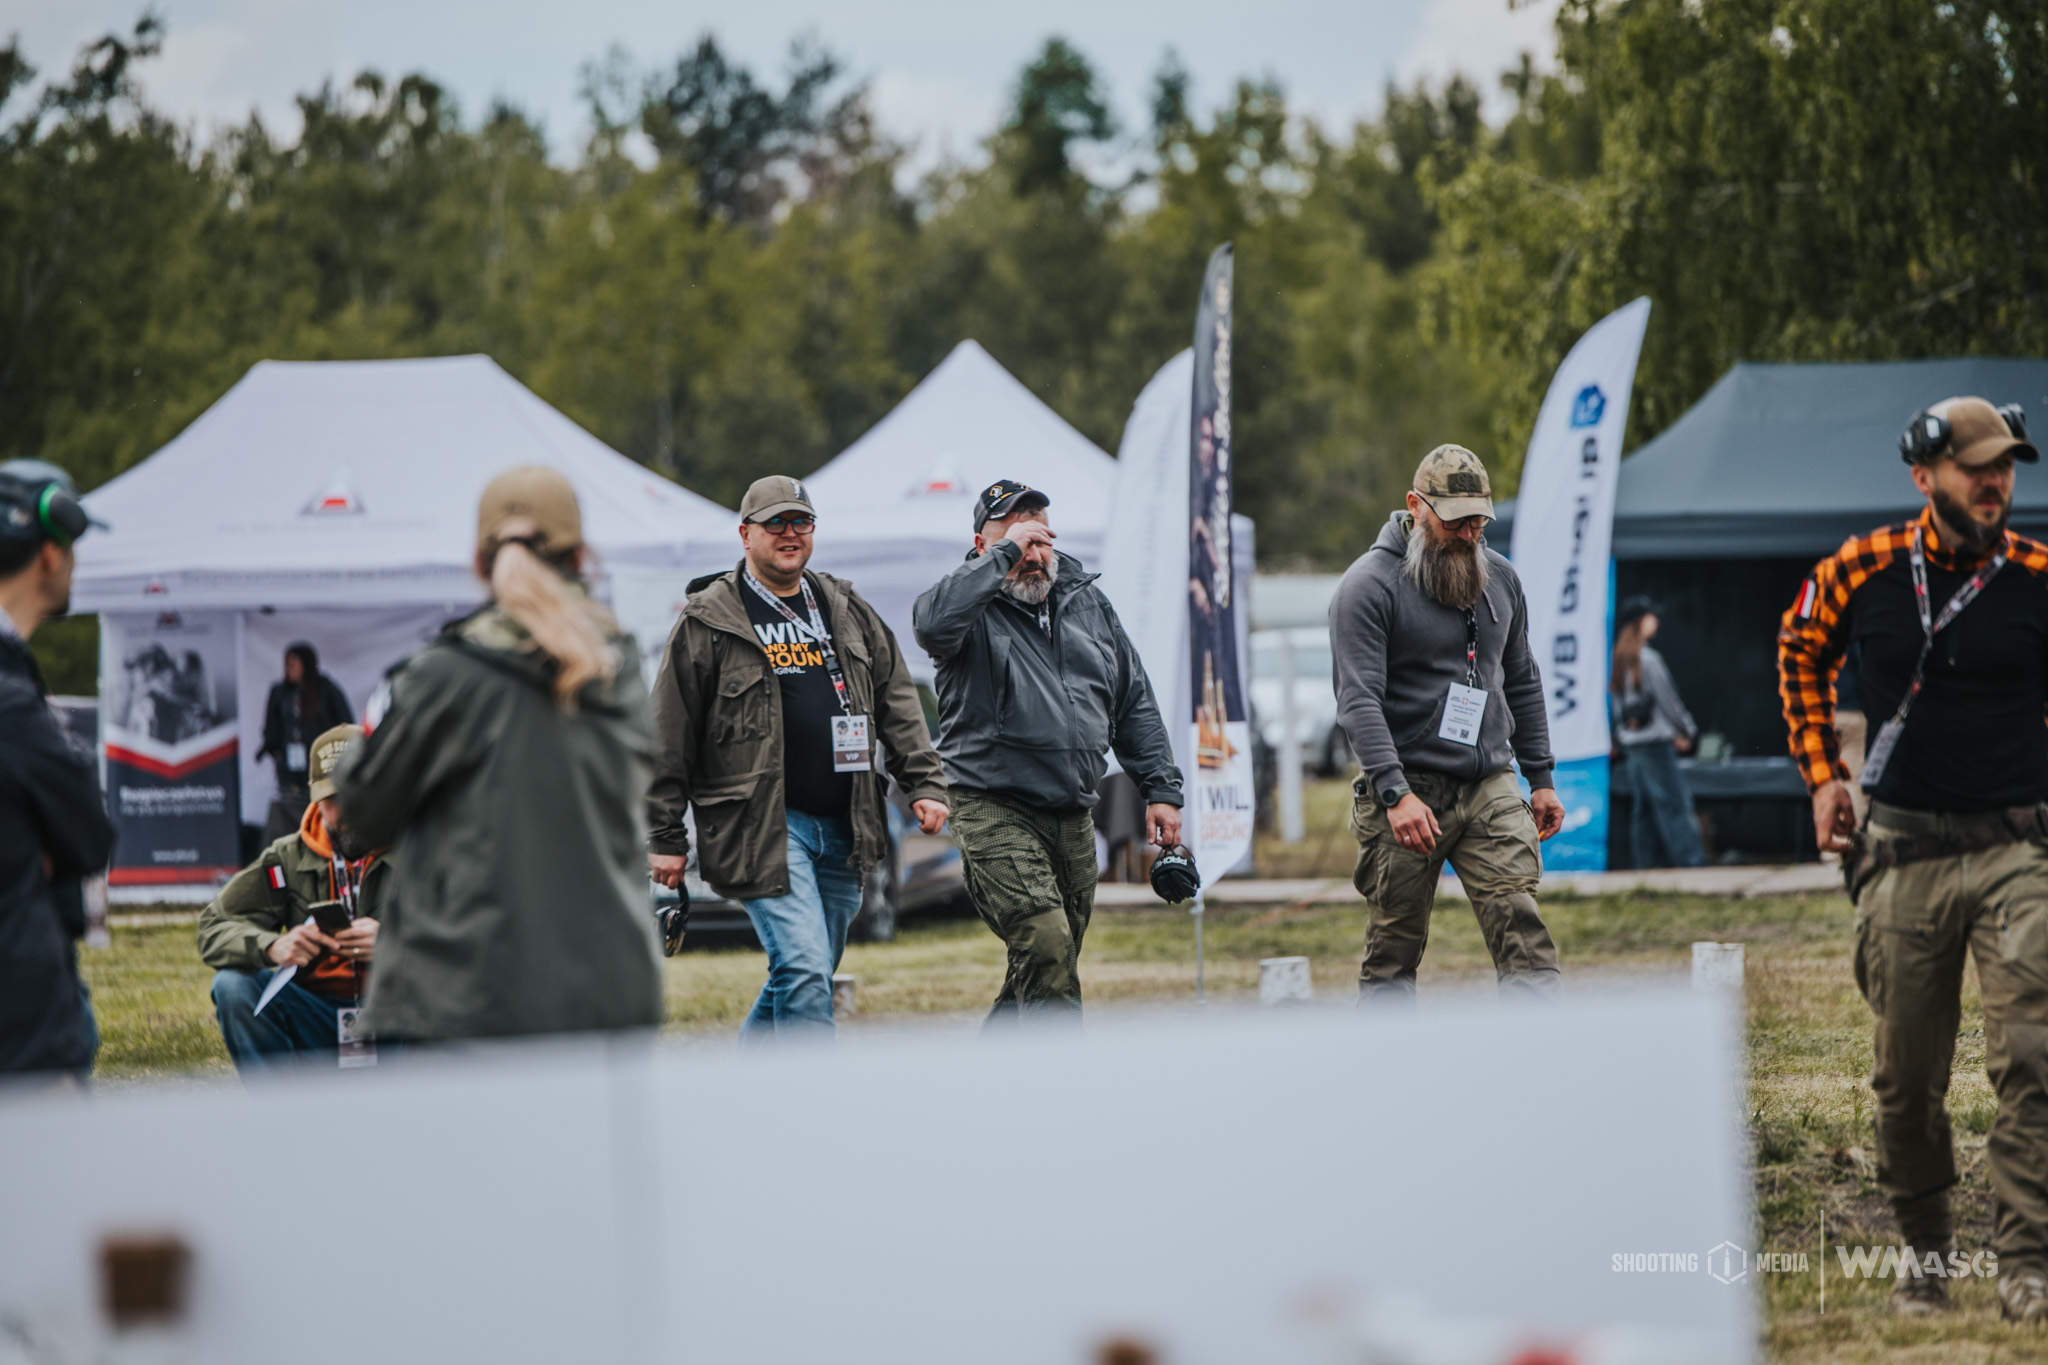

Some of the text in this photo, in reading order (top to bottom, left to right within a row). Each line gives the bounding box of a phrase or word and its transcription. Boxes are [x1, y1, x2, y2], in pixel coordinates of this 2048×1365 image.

[754, 622, 832, 645] WIL
[789, 643, 809, 652] MY
[767, 650, 824, 668] ROUN
[845, 752, 860, 761] VIP
